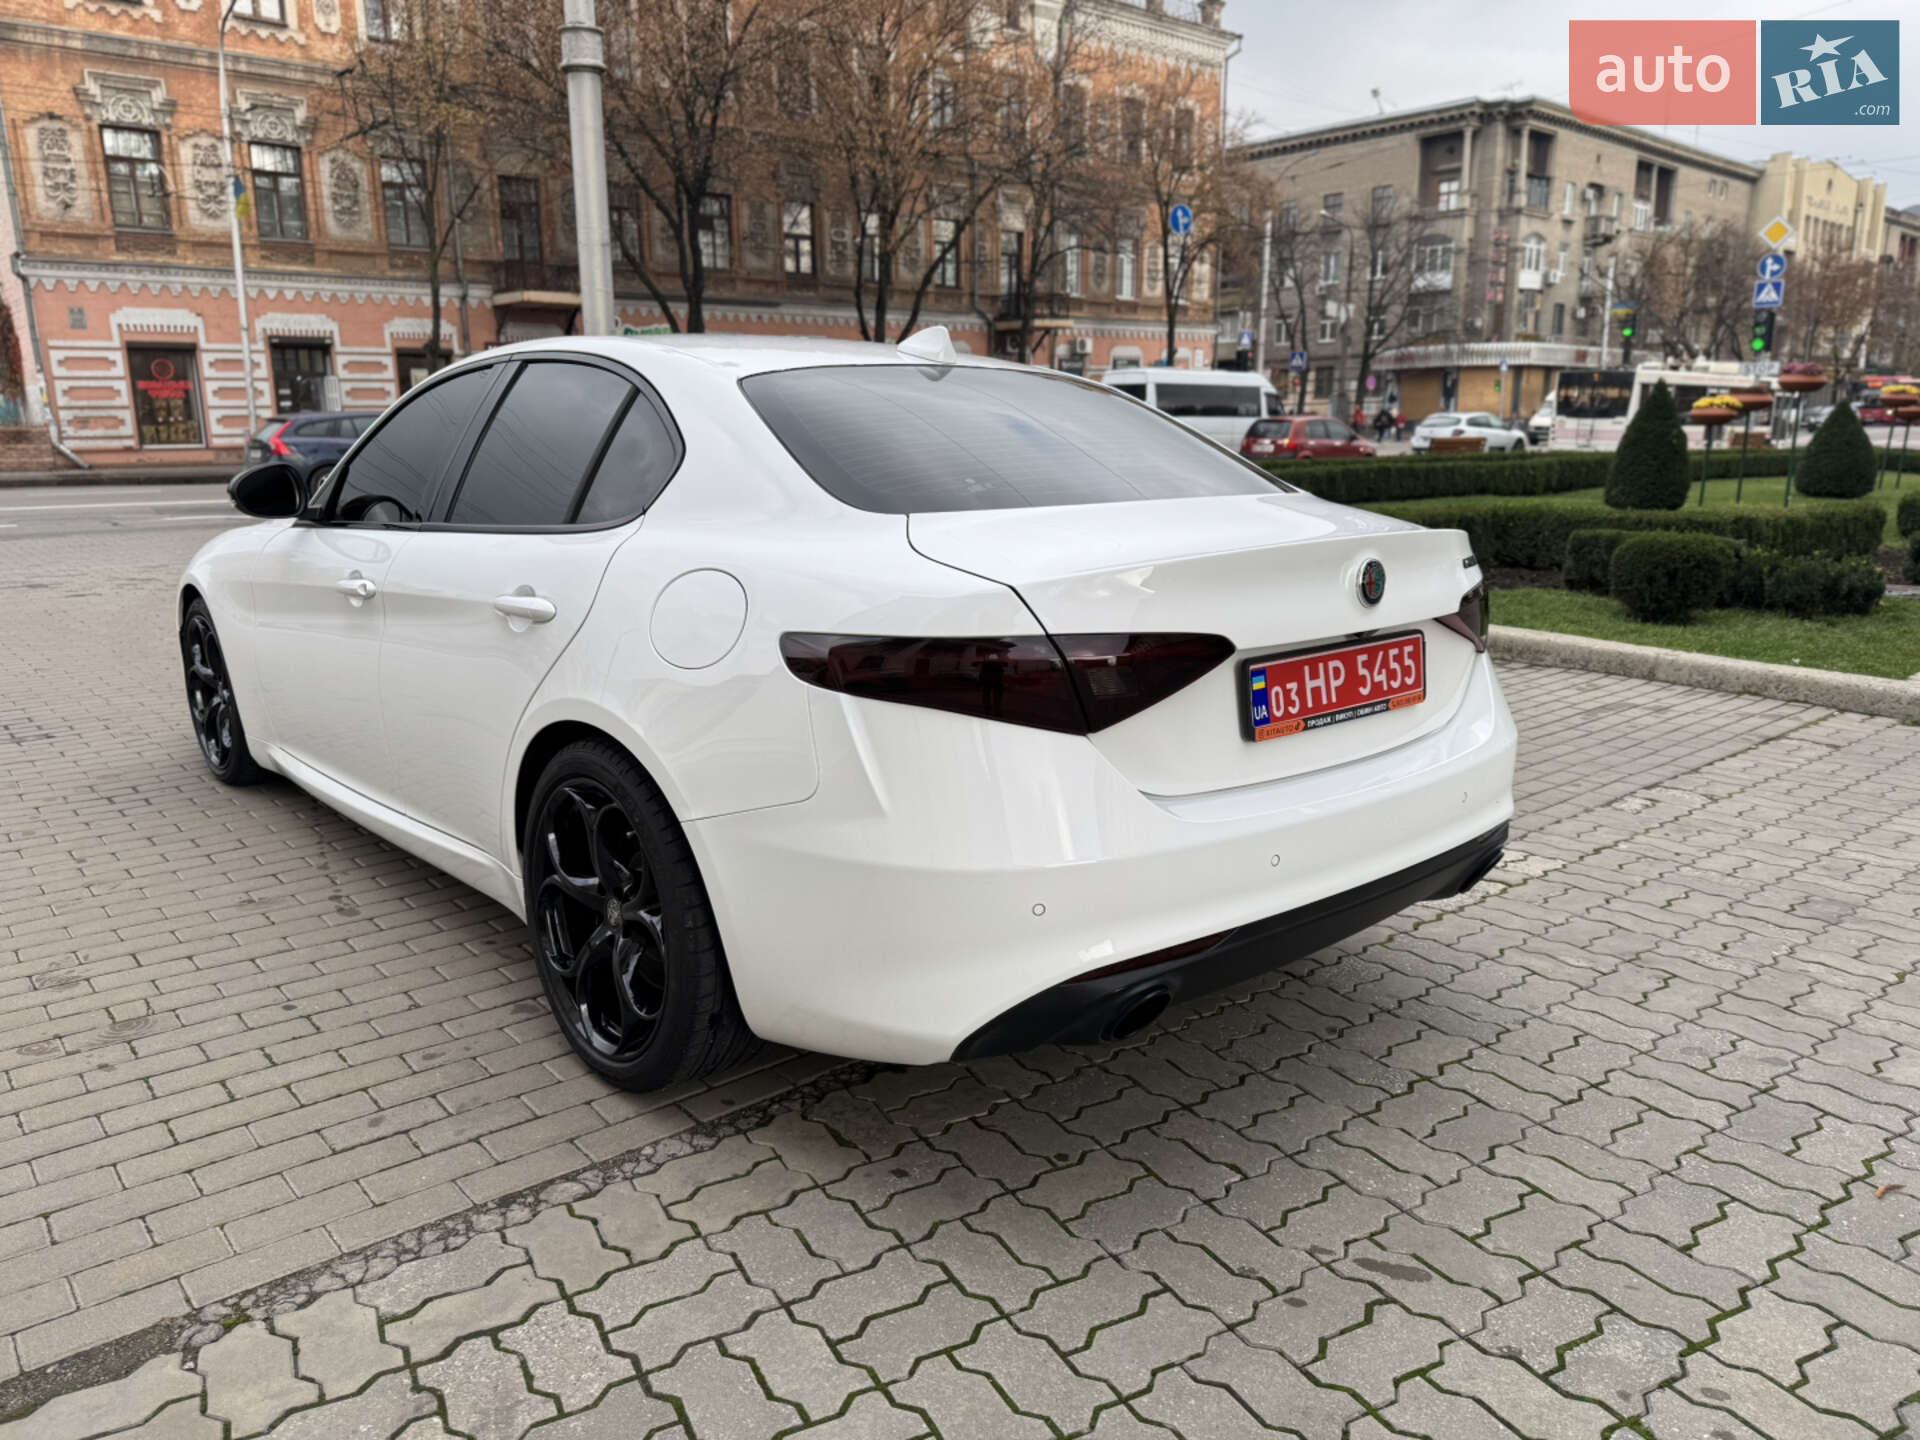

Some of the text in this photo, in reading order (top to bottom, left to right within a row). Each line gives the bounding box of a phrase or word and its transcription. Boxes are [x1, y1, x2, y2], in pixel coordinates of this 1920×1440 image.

[1271, 645, 1416, 718] 03 HP 5455
[1254, 705, 1269, 720] UA
[1307, 717, 1332, 728] ПРОДАЖ
